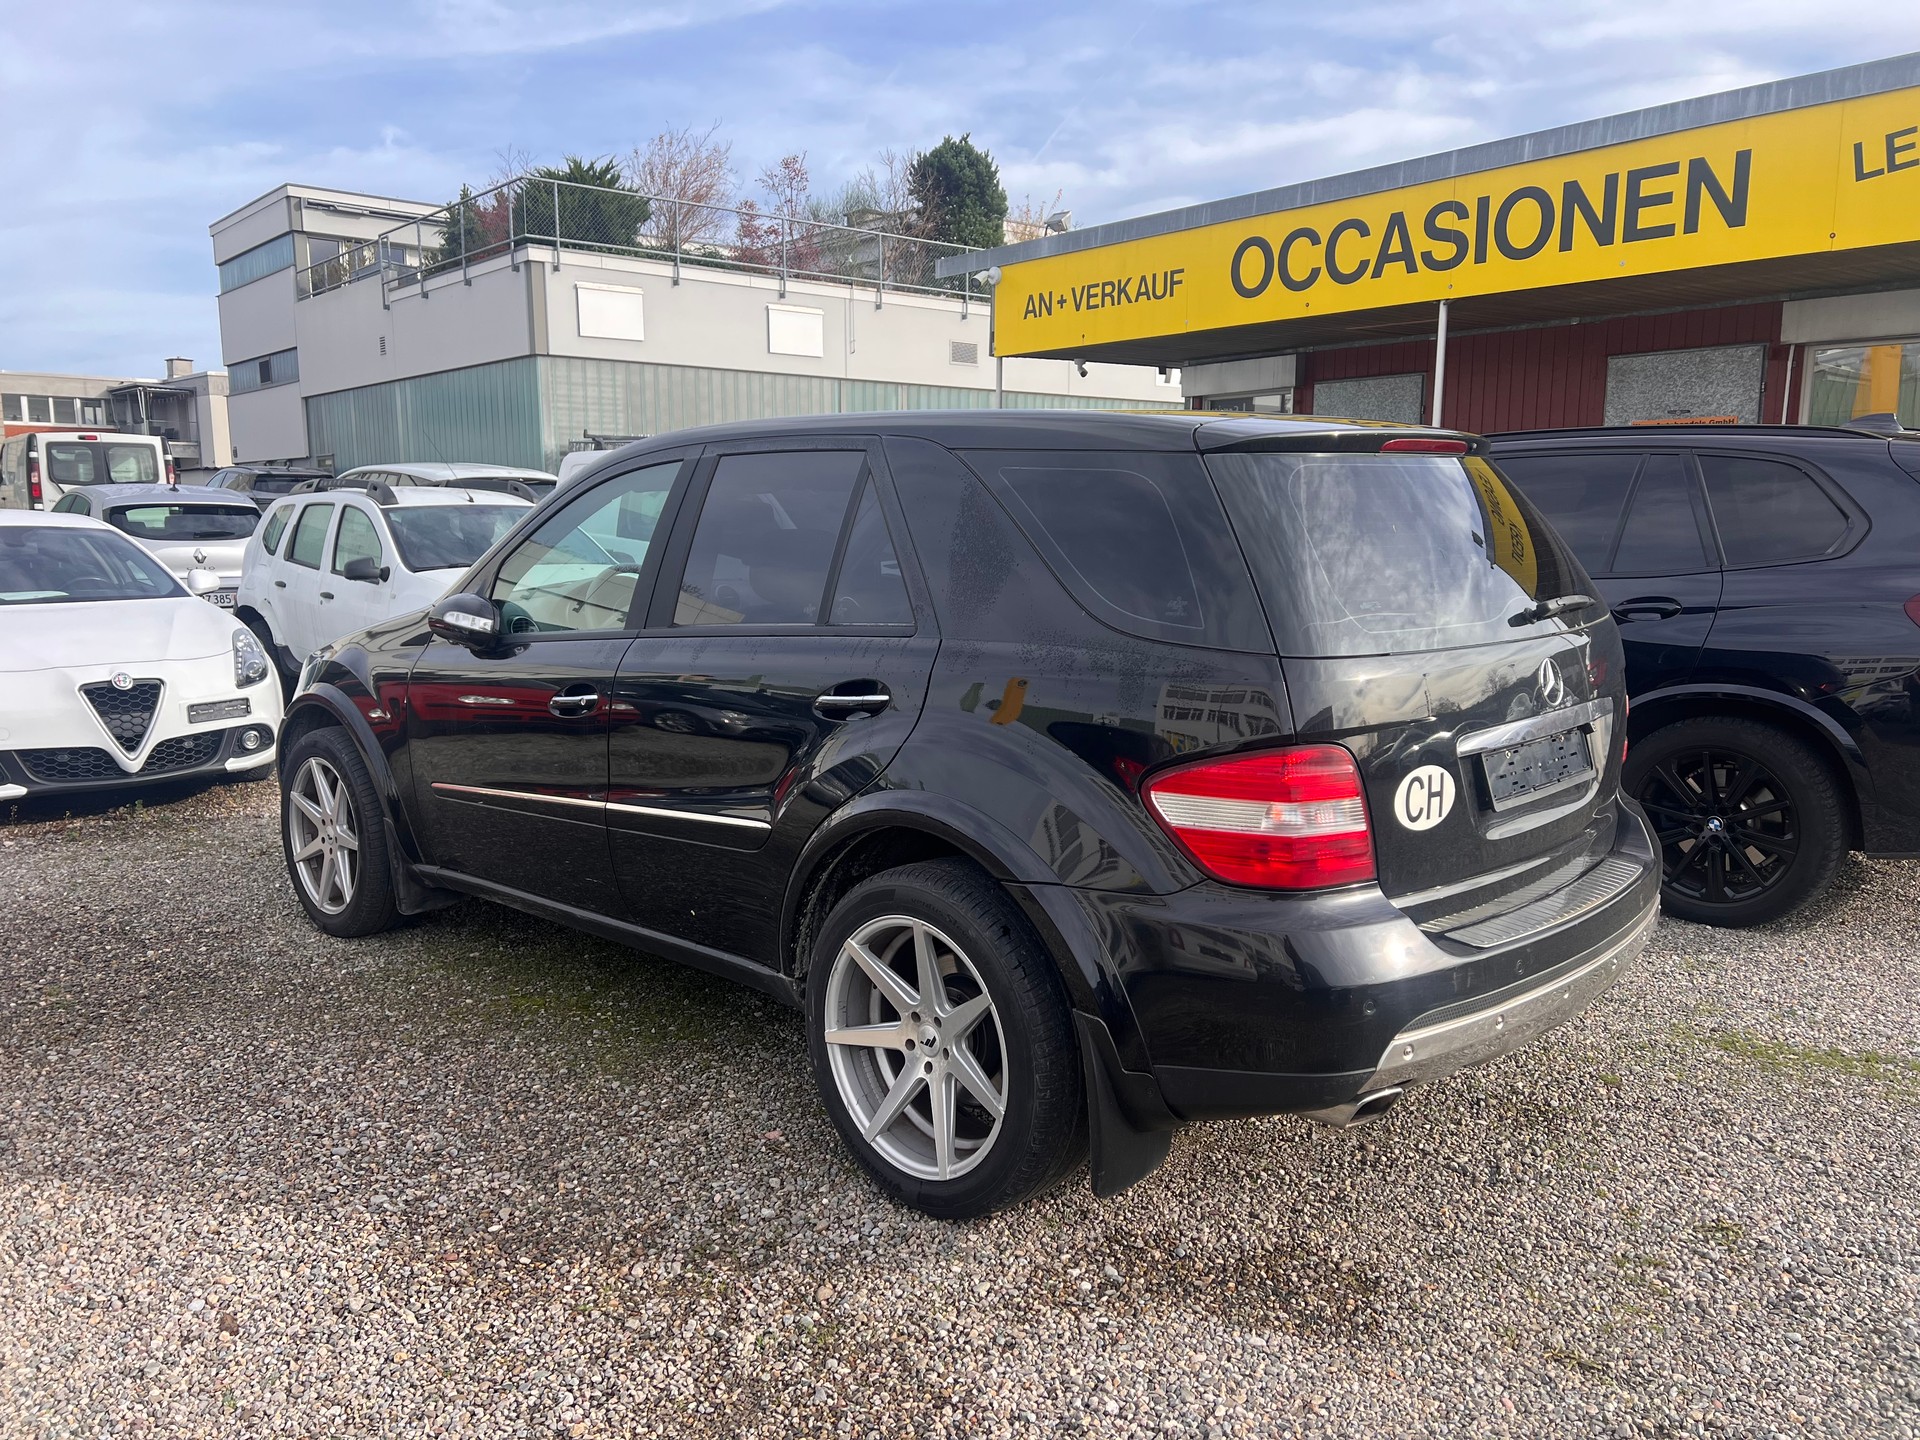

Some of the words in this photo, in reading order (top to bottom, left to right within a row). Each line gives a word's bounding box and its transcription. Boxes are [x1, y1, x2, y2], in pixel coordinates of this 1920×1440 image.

[1231, 149, 1752, 299] OCCASIONEN
[1023, 291, 1053, 320] AN
[1071, 268, 1185, 312] VERKAUF
[213, 594, 231, 604] 385
[1405, 772, 1444, 823] CH
